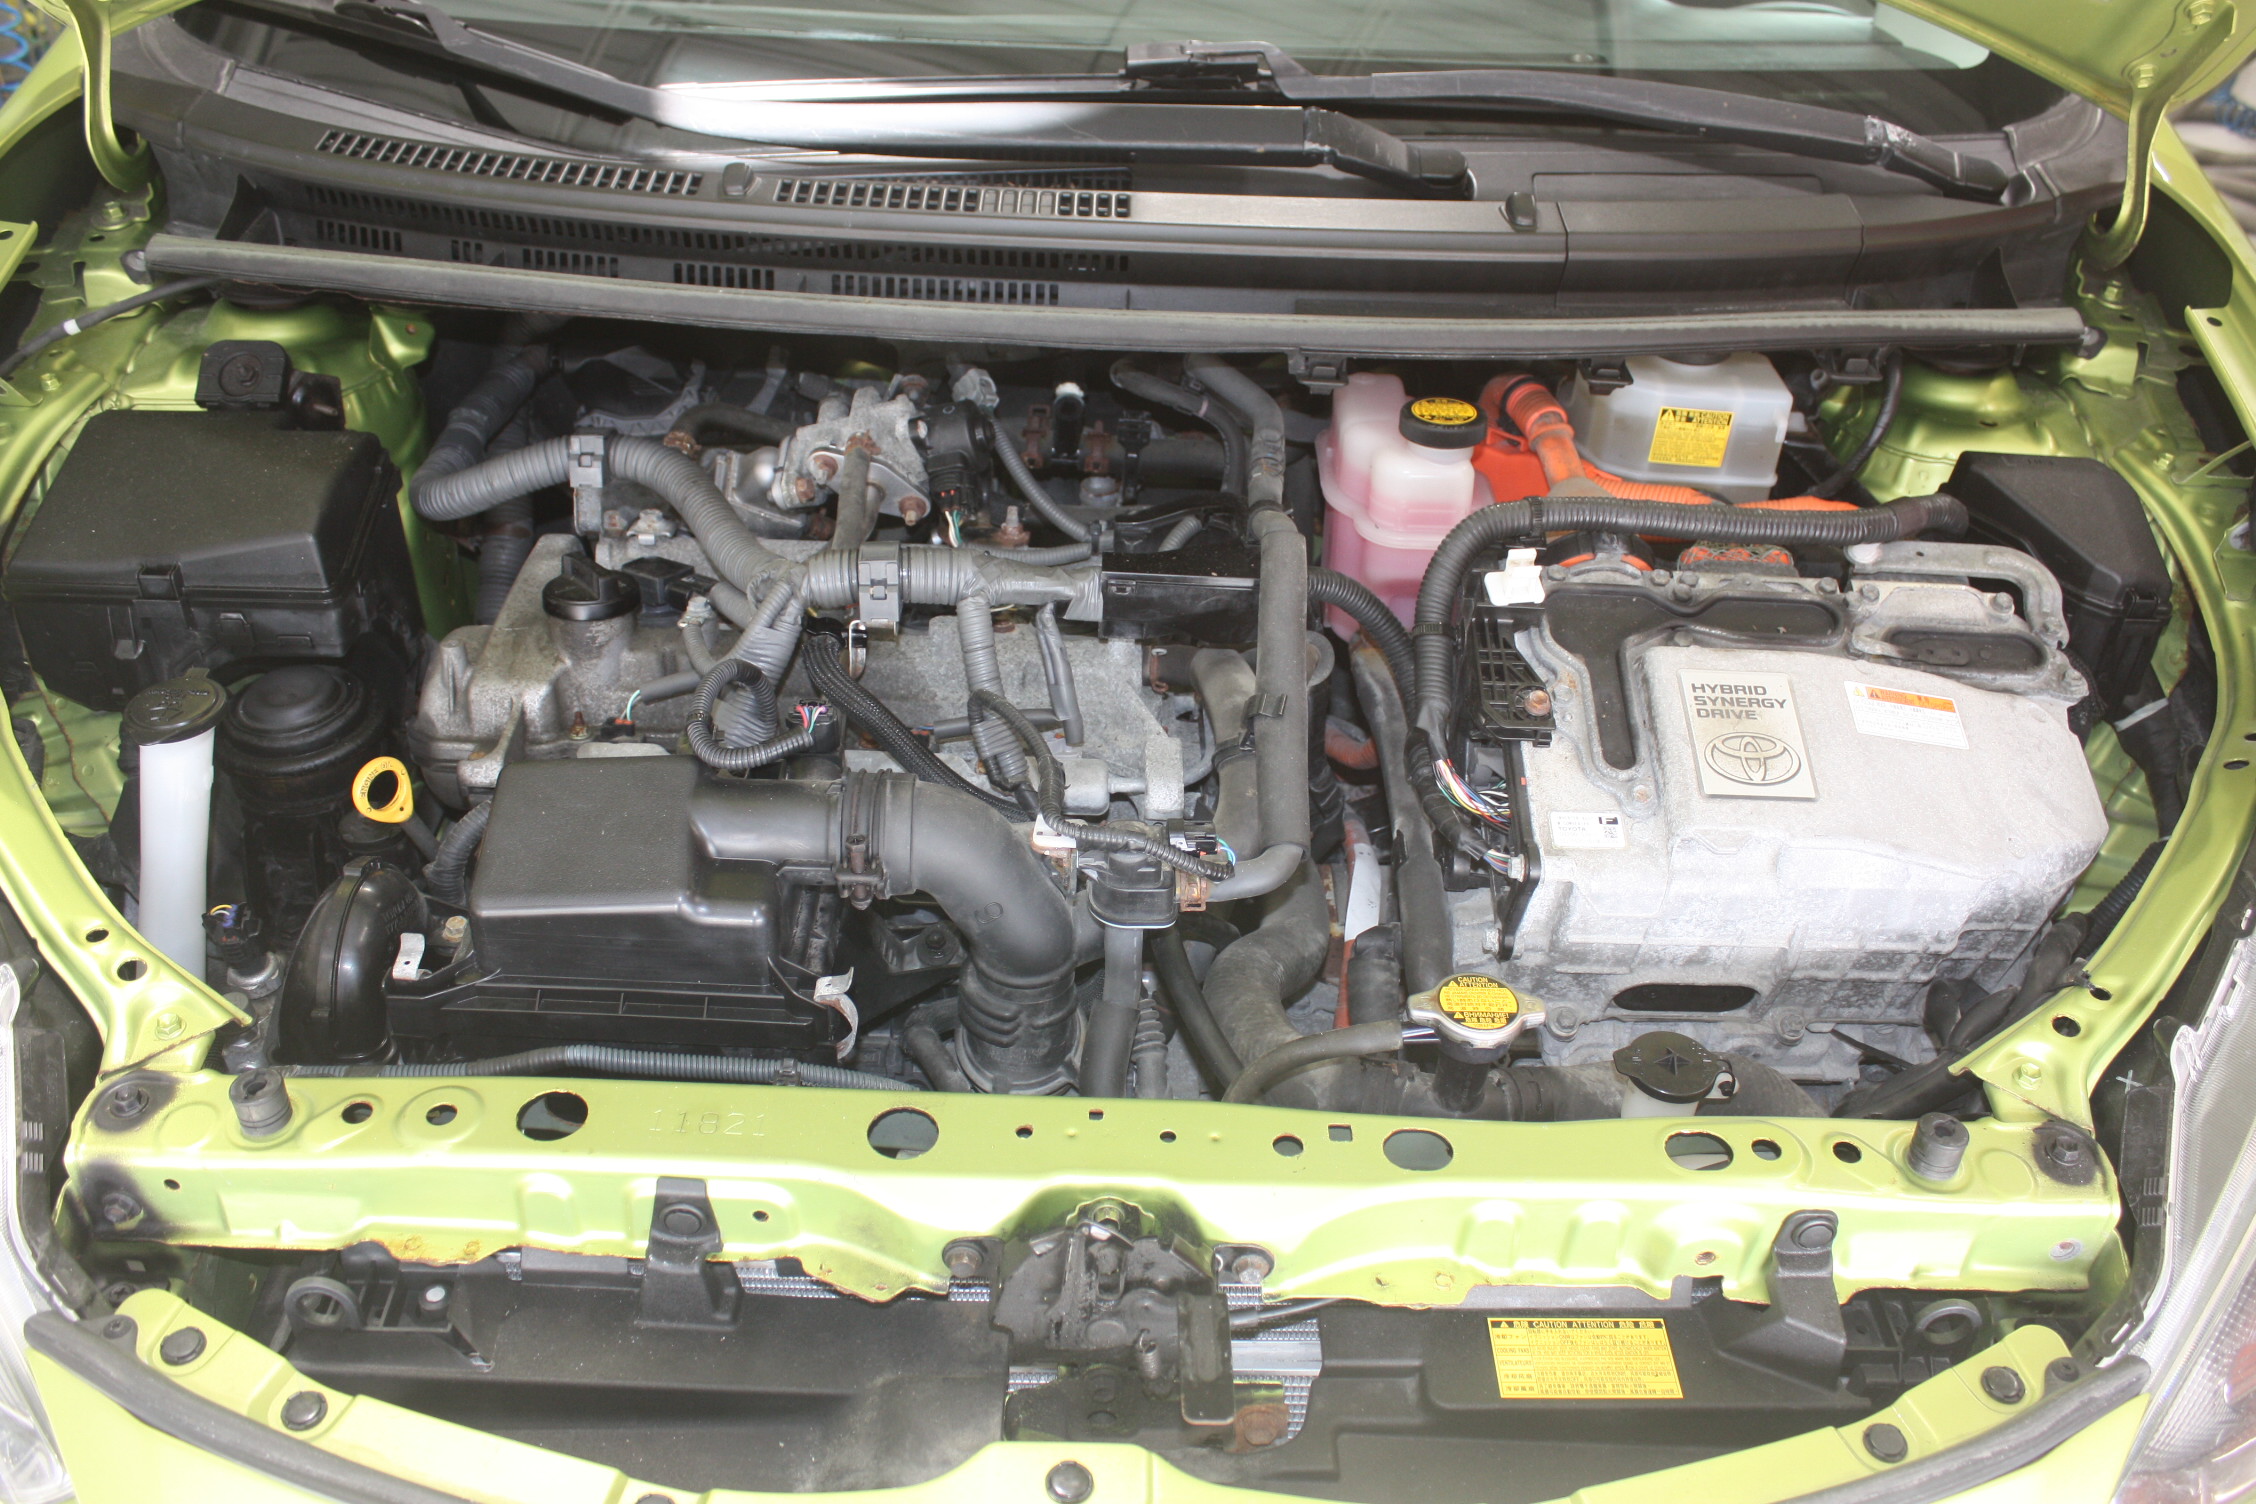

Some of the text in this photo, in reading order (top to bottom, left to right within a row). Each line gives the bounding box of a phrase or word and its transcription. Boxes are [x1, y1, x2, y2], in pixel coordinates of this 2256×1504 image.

[1691, 683, 1767, 696] HYBRID
[1693, 695, 1787, 709] SYNERGY
[1696, 707, 1758, 720] DRIVE
[650, 1109, 765, 1136] 11821
